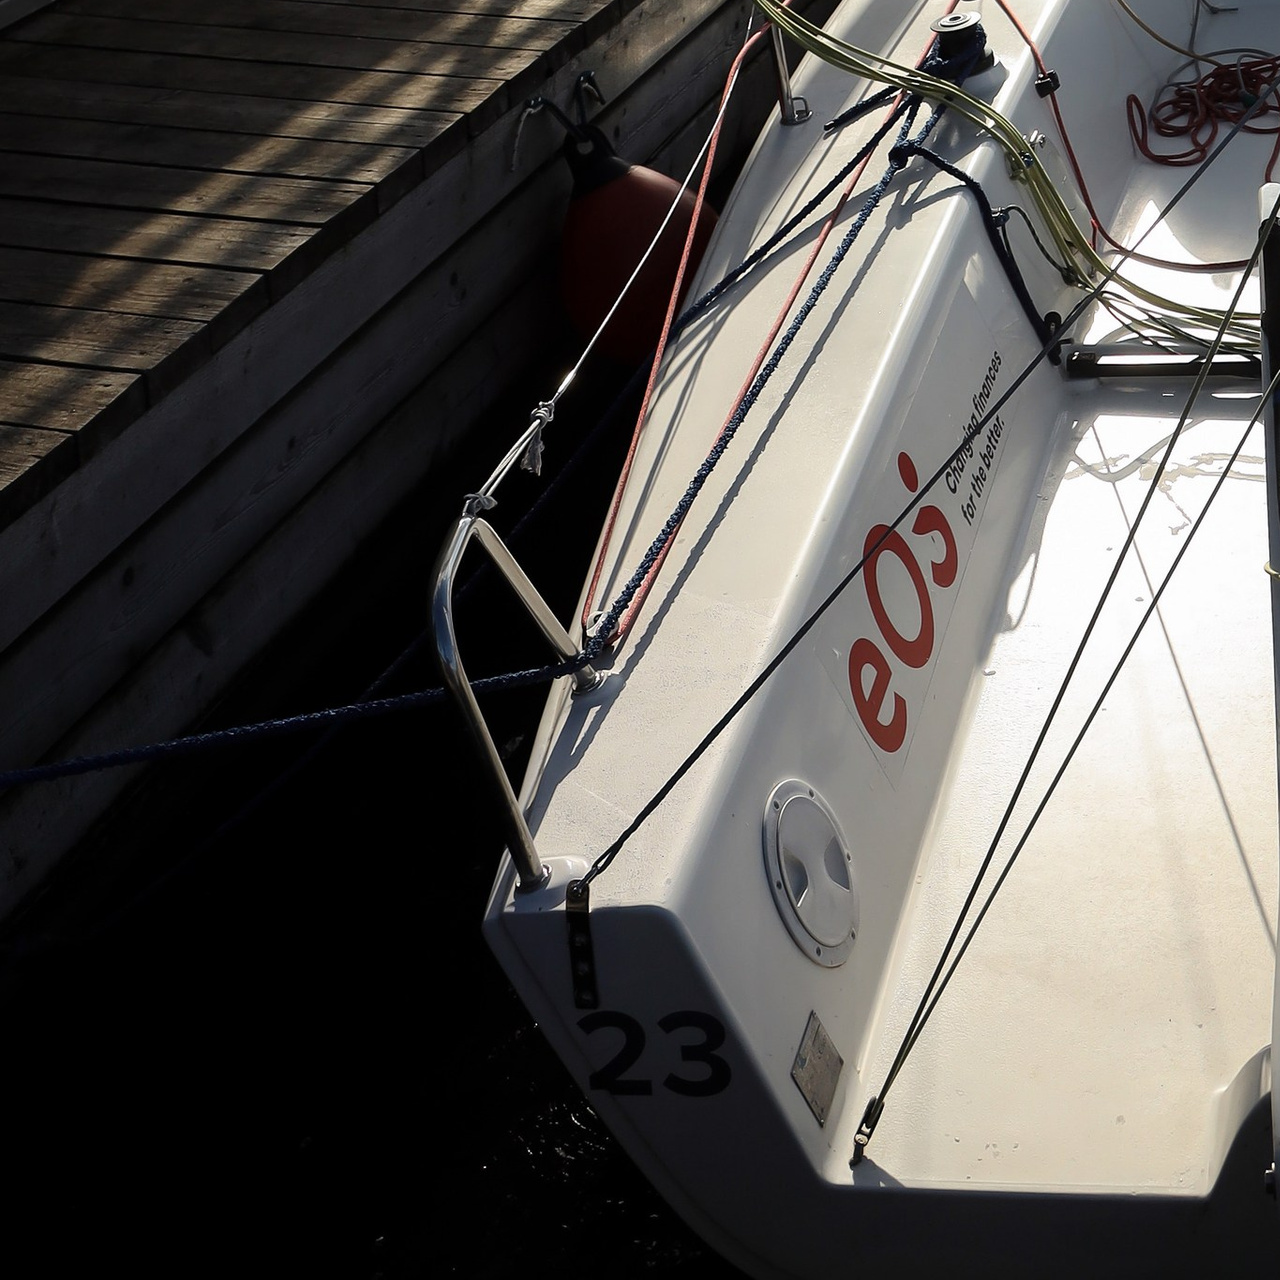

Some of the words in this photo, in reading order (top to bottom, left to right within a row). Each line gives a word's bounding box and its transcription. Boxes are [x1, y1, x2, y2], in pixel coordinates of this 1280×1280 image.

[972, 350, 1002, 419] finances
[961, 492, 977, 527] for
[971, 467, 987, 499] the
[979, 414, 1005, 471] better.
[576, 1010, 732, 1097] 23
